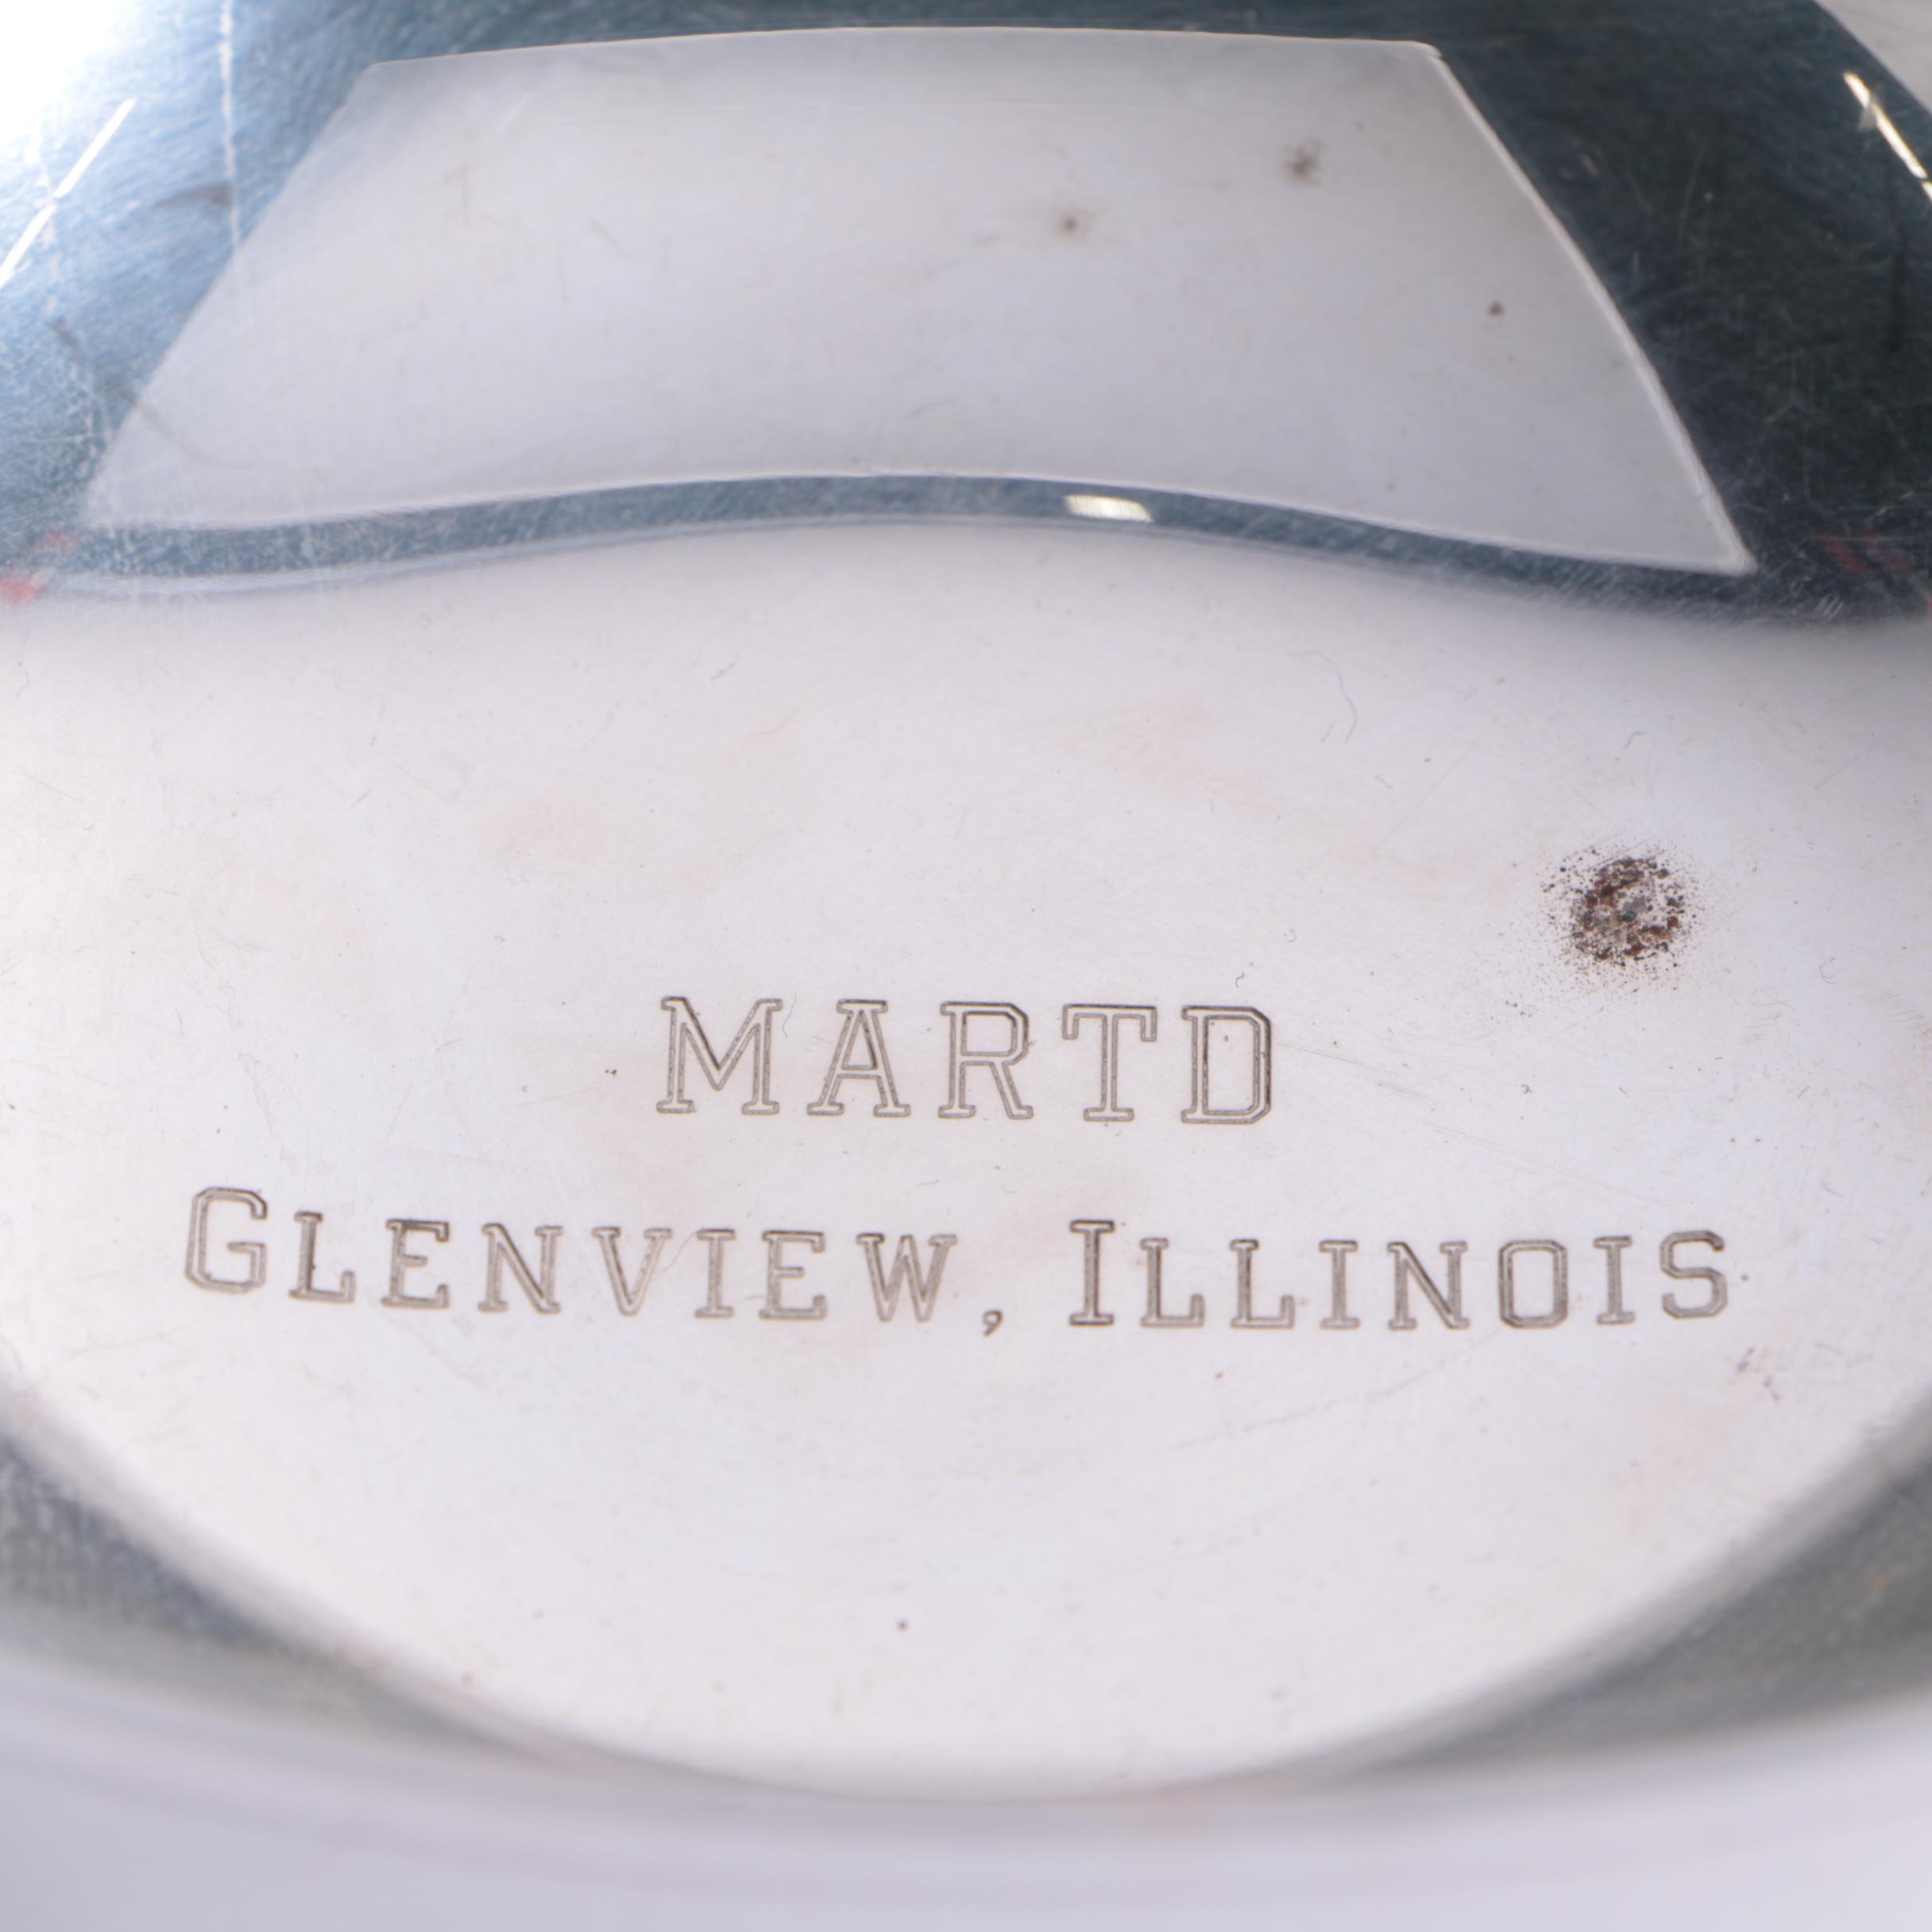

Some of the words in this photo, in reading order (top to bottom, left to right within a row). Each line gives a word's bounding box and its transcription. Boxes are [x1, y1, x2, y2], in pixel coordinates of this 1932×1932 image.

[655, 995, 1273, 1126] MARTD
[184, 1186, 1004, 1337] GLENVIEW,
[1068, 1218, 1729, 1331] ILLINOIS
